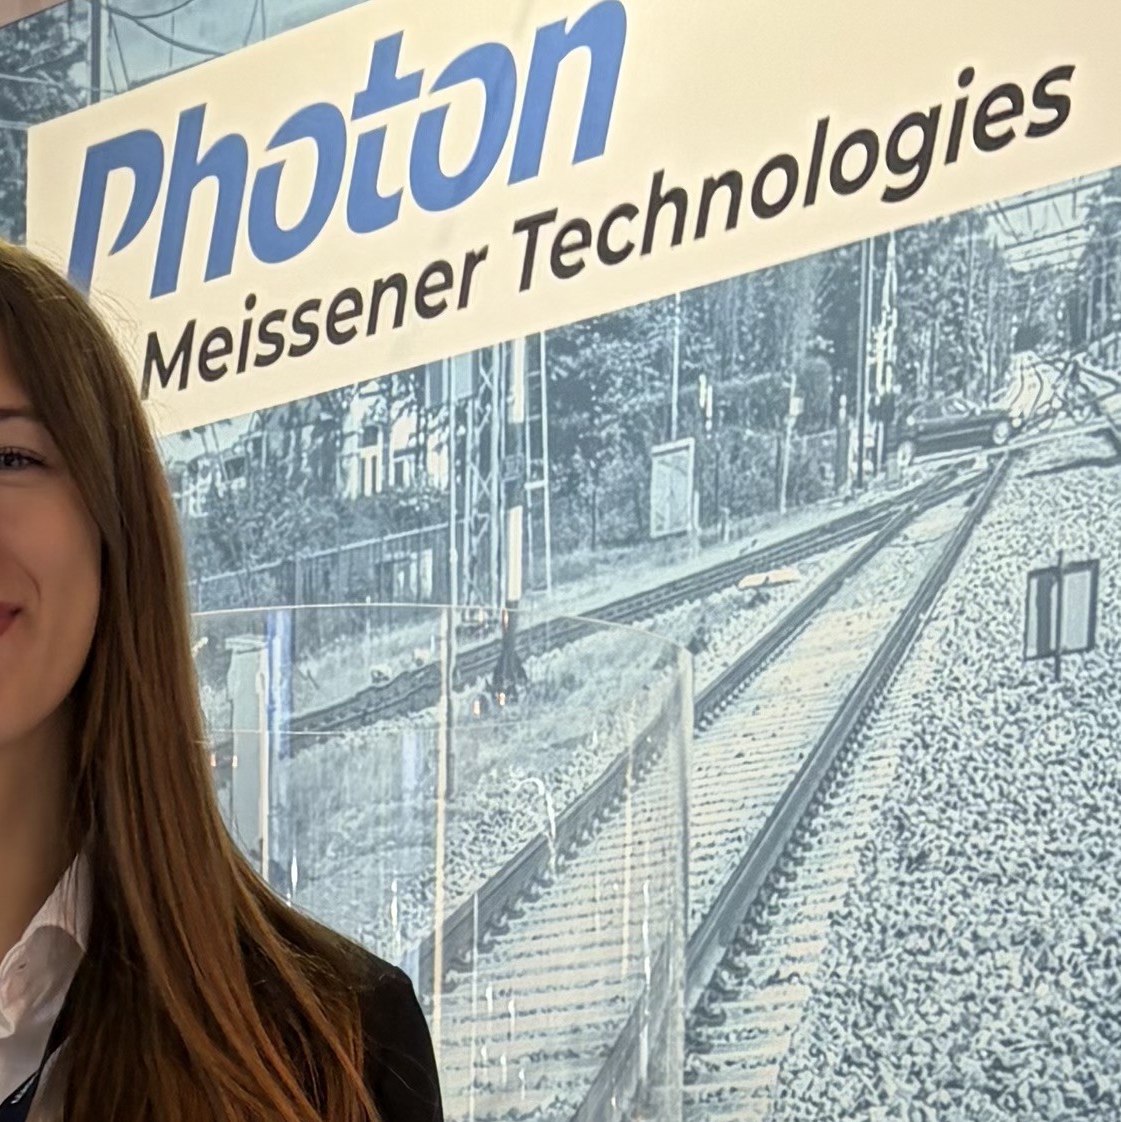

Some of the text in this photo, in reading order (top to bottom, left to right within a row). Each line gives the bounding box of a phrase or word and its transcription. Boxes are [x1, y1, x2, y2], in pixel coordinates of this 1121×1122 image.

[68, 0, 627, 299] Photon
[141, 65, 1075, 400] Meissener Technologies
